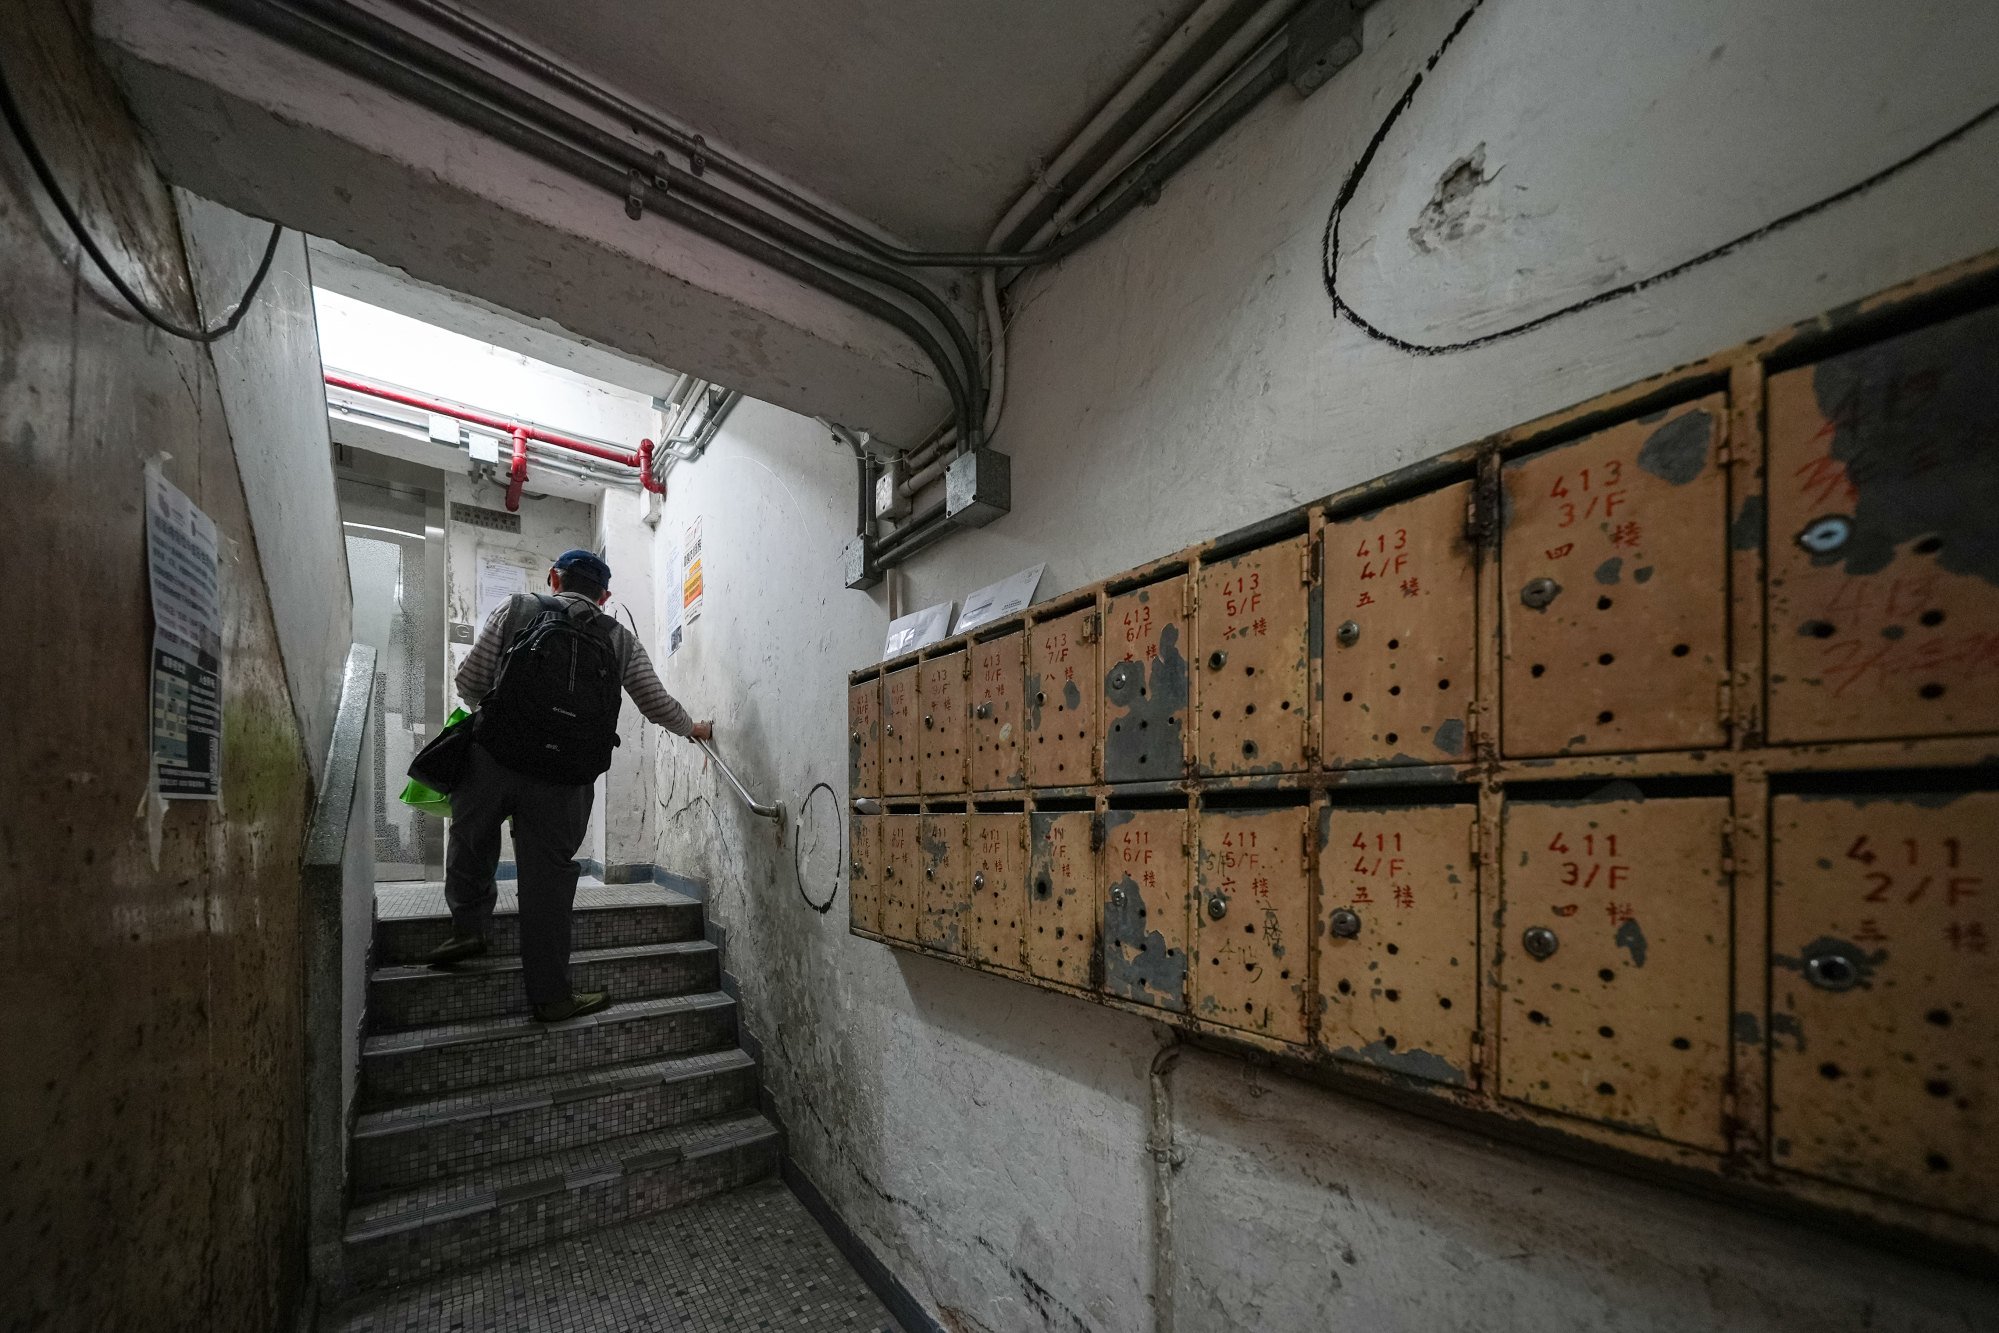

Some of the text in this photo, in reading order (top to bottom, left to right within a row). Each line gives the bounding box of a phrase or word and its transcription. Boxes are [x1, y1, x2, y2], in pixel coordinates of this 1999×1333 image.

[1551, 460, 1622, 500] 413
[1559, 492, 1626, 528] 3/F
[1357, 528, 1407, 558] 413
[1360, 553, 1408, 581] 4/F
[1223, 573, 1260, 597] 413
[1226, 593, 1262, 617] 5/F
[1124, 606, 1150, 625] 413
[1045, 634, 1067, 650] 413
[1127, 622, 1152, 642] 6/F
[984, 653, 1000, 668] 413
[1048, 648, 1069, 664] 7/F
[981, 827, 999, 840] 411
[1123, 829, 1149, 844] 411
[1223, 831, 1258, 848] 411
[1352, 831, 1403, 850] 411
[1549, 832, 1618, 857] 411
[1845, 833, 1962, 869] 411
[1123, 847, 1153, 864] 6/F
[1226, 852, 1259, 868] 5/F
[1355, 858, 1405, 877] 4/F
[1561, 862, 1630, 889] 3/F
[1222, 877, 1269, 898] 六楼
[1862, 871, 1984, 907] 2/F
